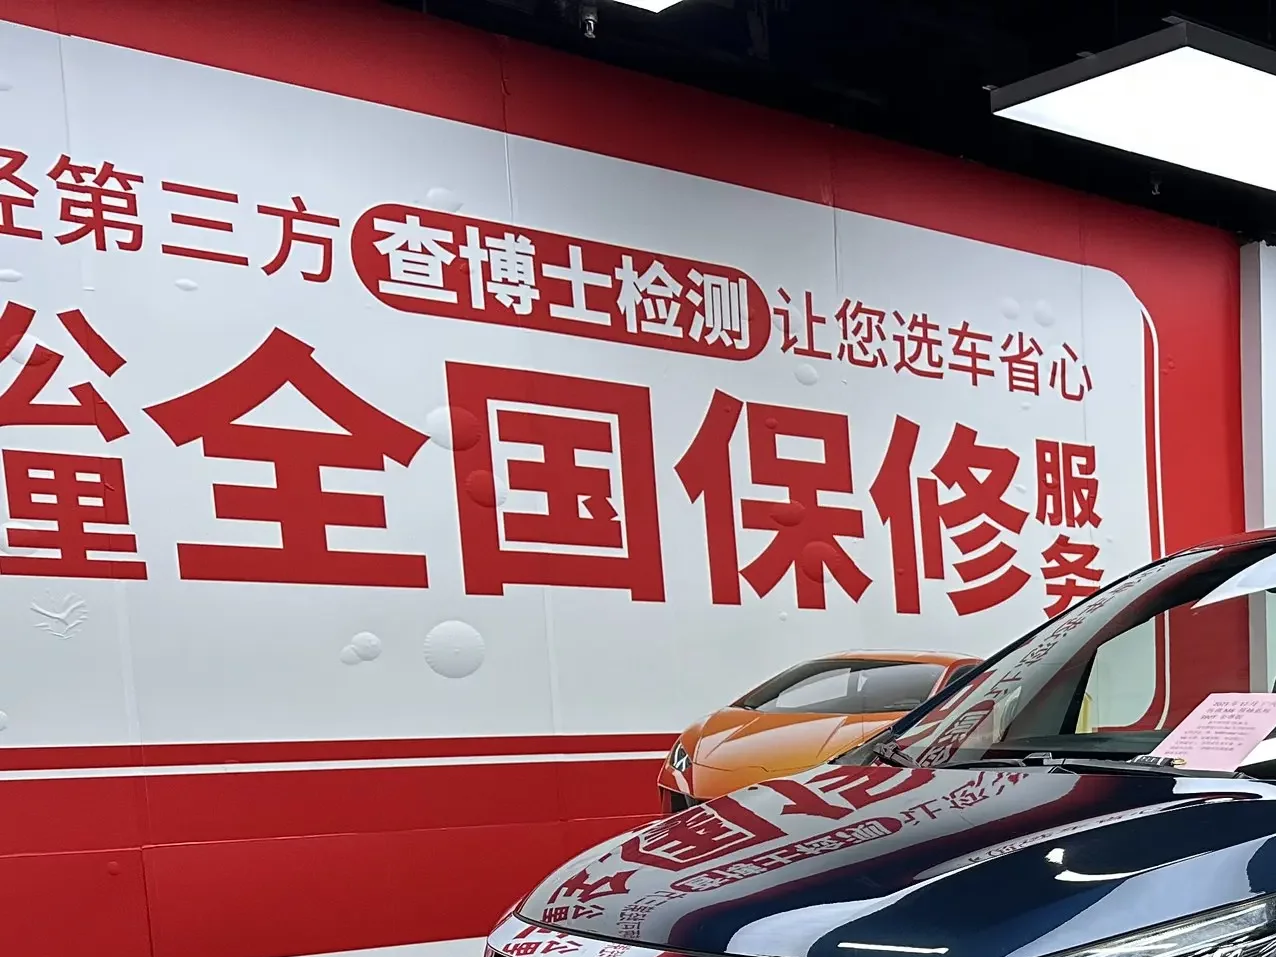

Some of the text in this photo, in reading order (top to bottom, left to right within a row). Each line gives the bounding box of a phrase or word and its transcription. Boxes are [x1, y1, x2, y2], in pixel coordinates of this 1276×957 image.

[371, 214, 750, 353] 查博士检测
[772, 286, 1095, 403] 让您选车省心
[141, 326, 1032, 618] 全国保修
[1034, 438, 1105, 620] 服务
